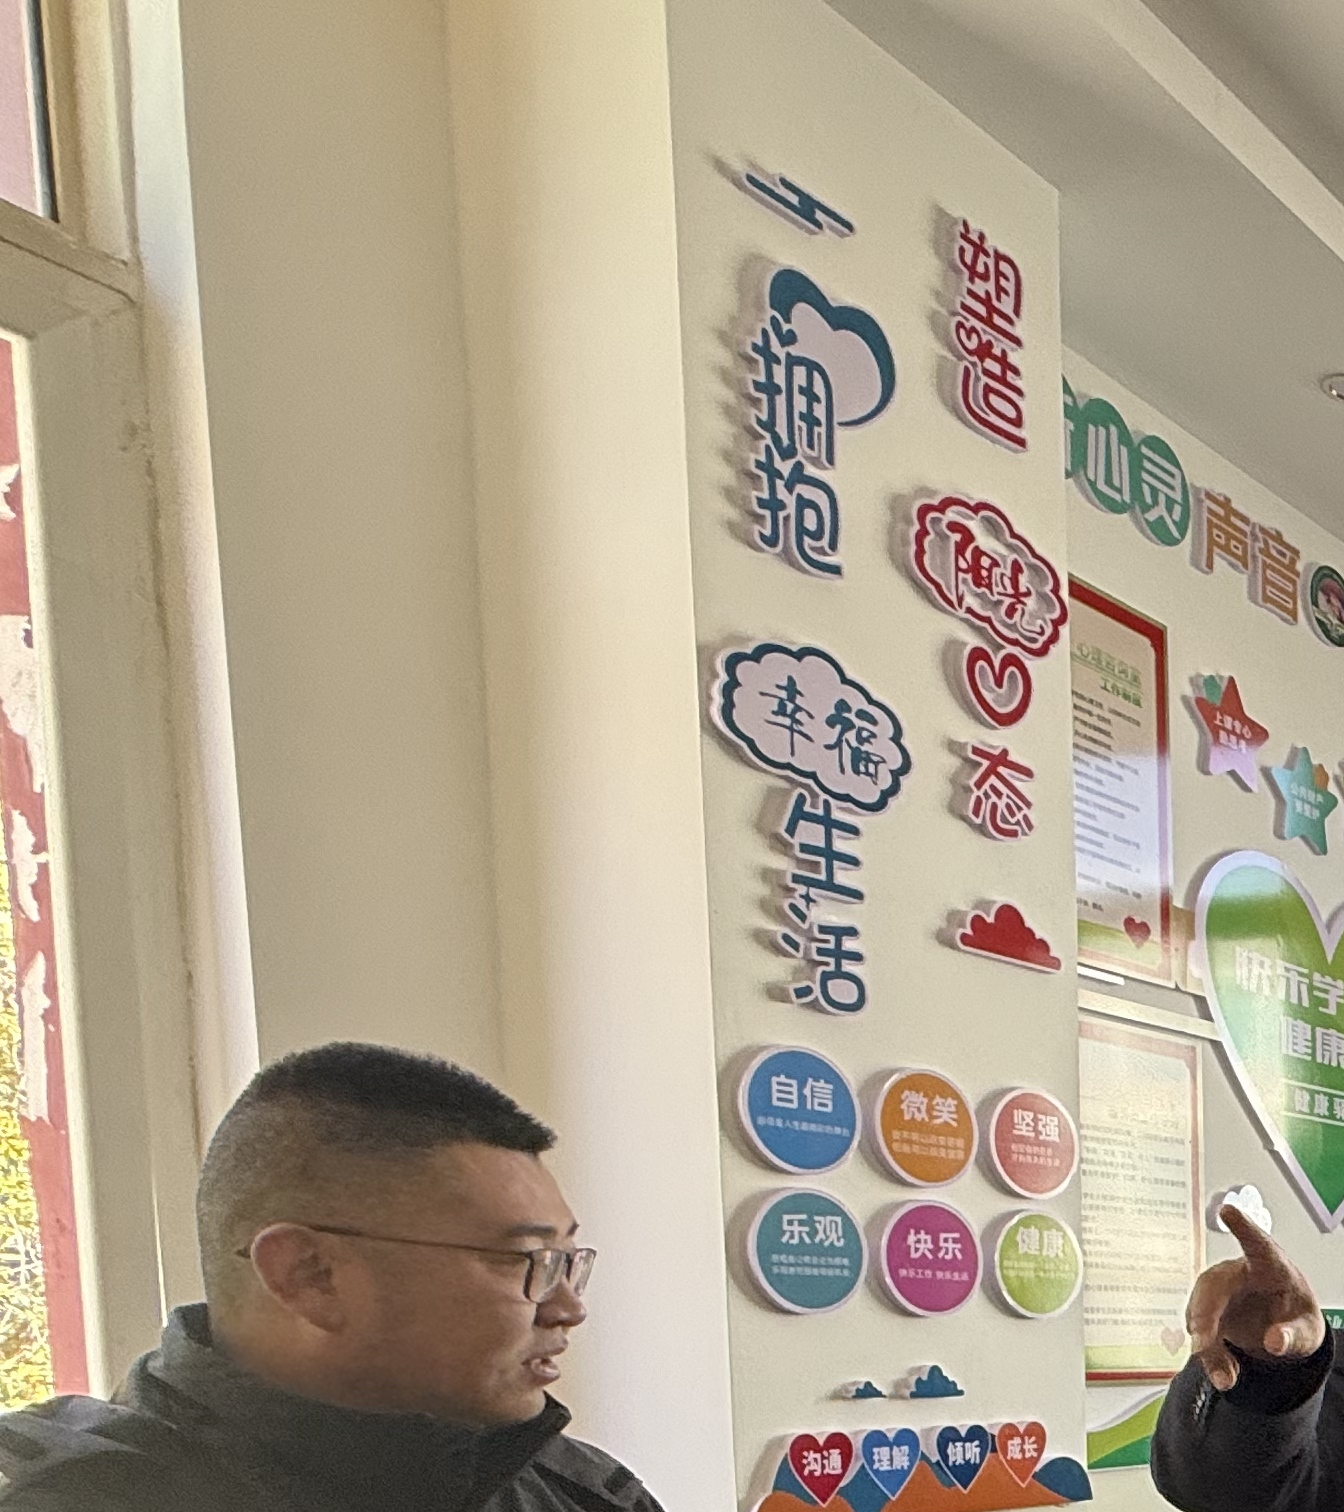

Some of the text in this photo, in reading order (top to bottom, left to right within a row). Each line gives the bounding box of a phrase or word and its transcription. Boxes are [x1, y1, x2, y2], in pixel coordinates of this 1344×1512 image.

[954, 218, 1026, 450] 塑造
[1204, 488, 1300, 625] 声音
[945, 520, 1046, 638] 阳光
[749, 314, 888, 1013] 拥抱 幸福 生活
[770, 1074, 834, 1113] 自信
[900, 1090, 958, 1127] 微笑
[1012, 1108, 1060, 1143] 坚强
[780, 1213, 845, 1247] 乐观
[906, 1228, 963, 1260] 快乐
[1016, 1225, 1064, 1258] 健康
[801, 1435, 1039, 1477] 沟通 理解 倾听 成长
